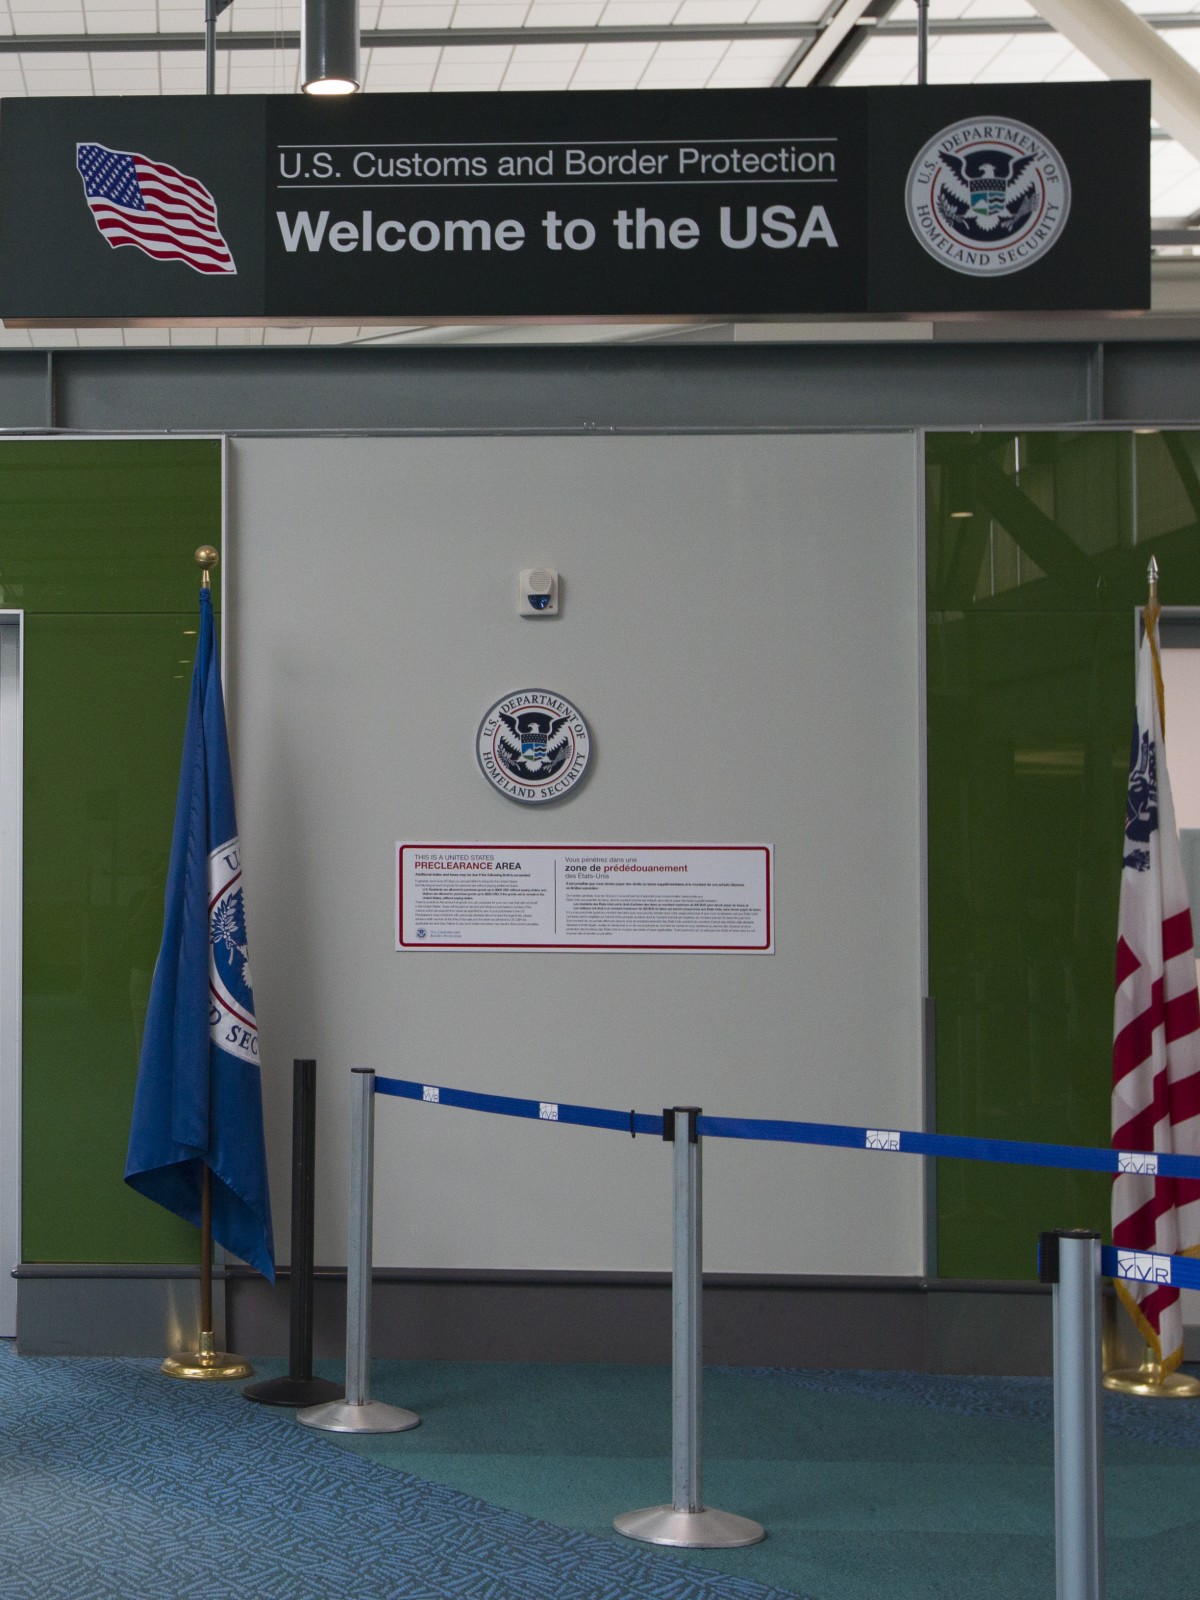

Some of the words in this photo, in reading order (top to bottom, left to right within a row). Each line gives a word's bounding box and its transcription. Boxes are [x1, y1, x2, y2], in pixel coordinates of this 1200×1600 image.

[279, 153, 341, 179] U.S.
[352, 151, 487, 178] Customs
[497, 150, 553, 177] and
[566, 148, 667, 176] Border
[679, 146, 836, 174] Protection
[918, 160, 938, 185] U.S.
[941, 126, 1046, 161] DEPARTMENT
[1043, 163, 1060, 185] OF
[276, 210, 525, 252] Welcome
[542, 210, 596, 251] to
[613, 207, 700, 250] the
[719, 205, 838, 249] USA
[917, 204, 990, 265] HOMELAND
[998, 203, 1060, 265] SECURITY
[483, 718, 499, 737] U.S.
[501, 694, 577, 722] DEPARTMENT
[574, 724, 586, 739] OF
[483, 752, 535, 797] HOMELAND
[541, 753, 585, 797] SECURITY
[414, 861, 493, 870] PRECLEARANCE
[495, 862, 522, 870] AREA
[590, 864, 601, 872] de
[604, 864, 688, 873] prédédouanement
[540, 1109, 557, 1119] YVR
[866, 1137, 898, 1150] YVR
[1118, 1160, 1156, 1174] YVR
[1118, 1261, 1169, 1283] YVR
